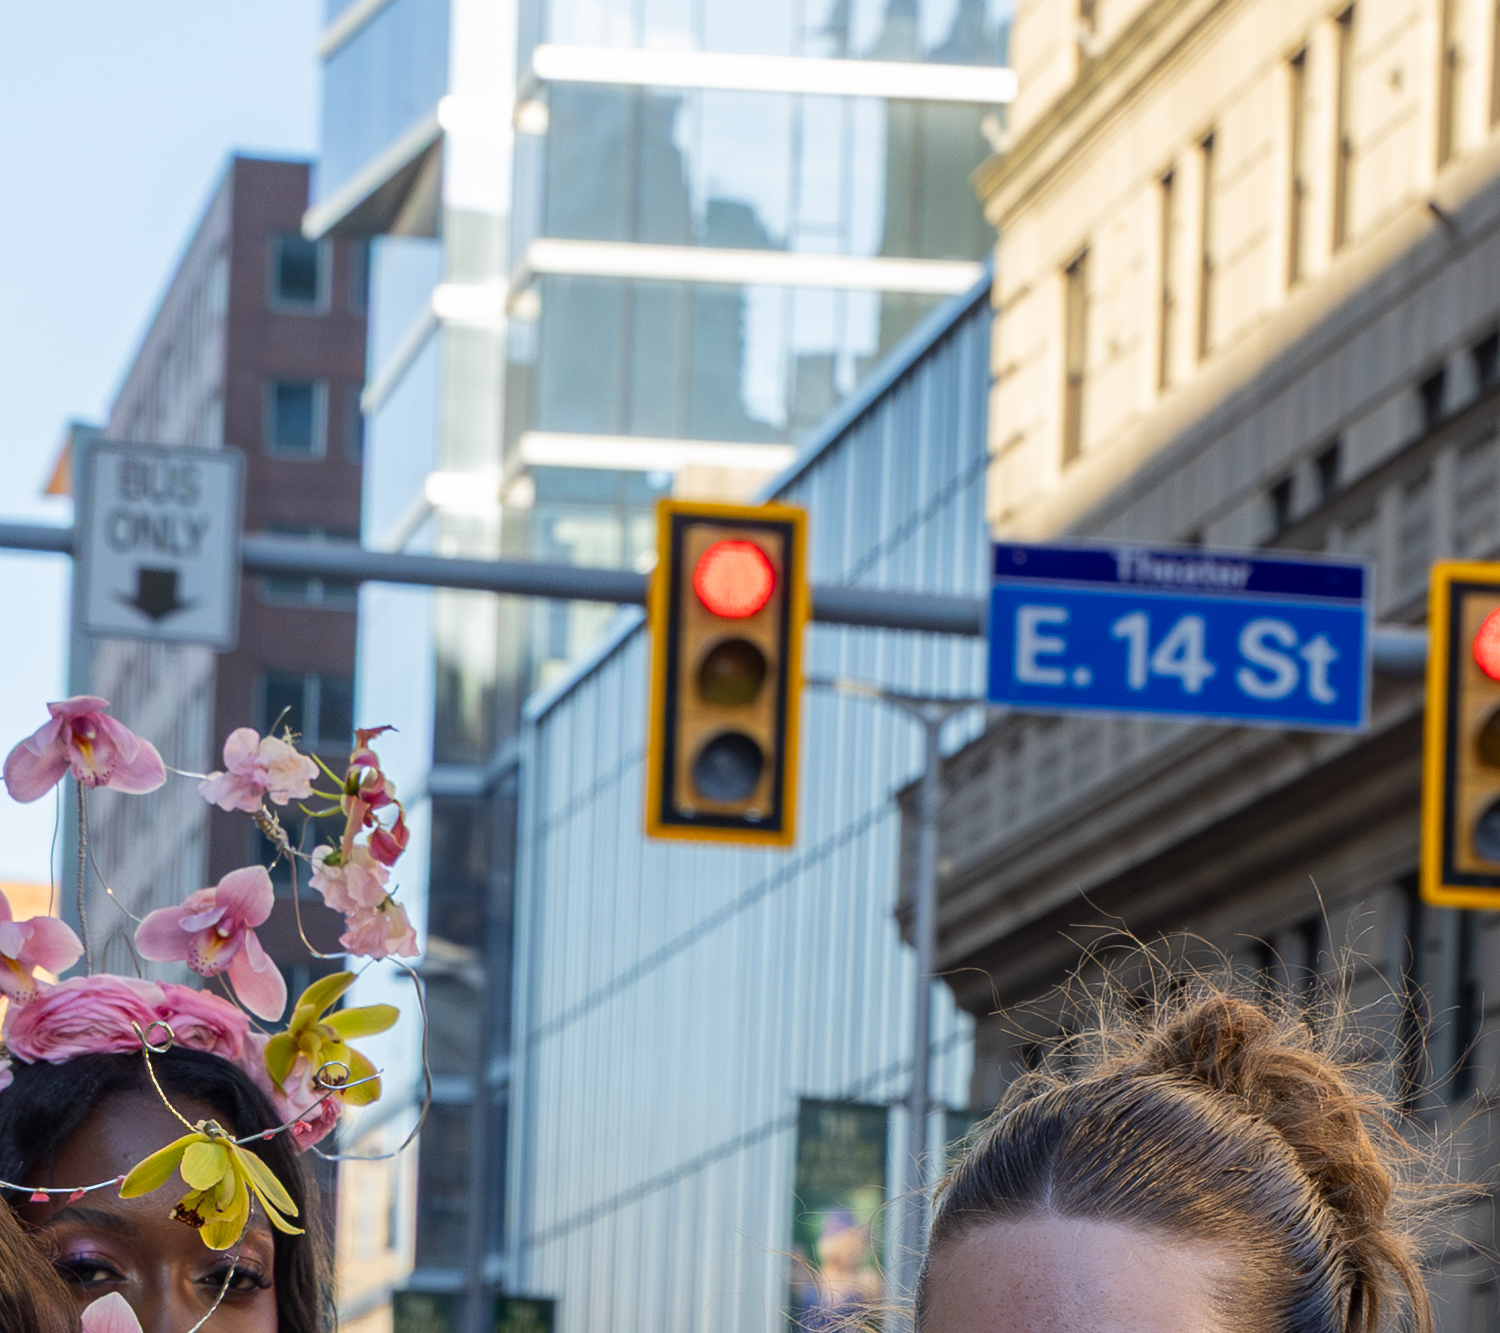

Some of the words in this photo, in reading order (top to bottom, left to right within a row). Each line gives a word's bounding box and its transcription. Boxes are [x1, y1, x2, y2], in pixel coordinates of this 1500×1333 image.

[117, 459, 201, 504] BUS
[104, 508, 211, 557] ONLY
[1112, 549, 1253, 588] Theater
[1015, 603, 1092, 688] E.
[1112, 611, 1217, 694] 14
[1237, 618, 1340, 705] St
